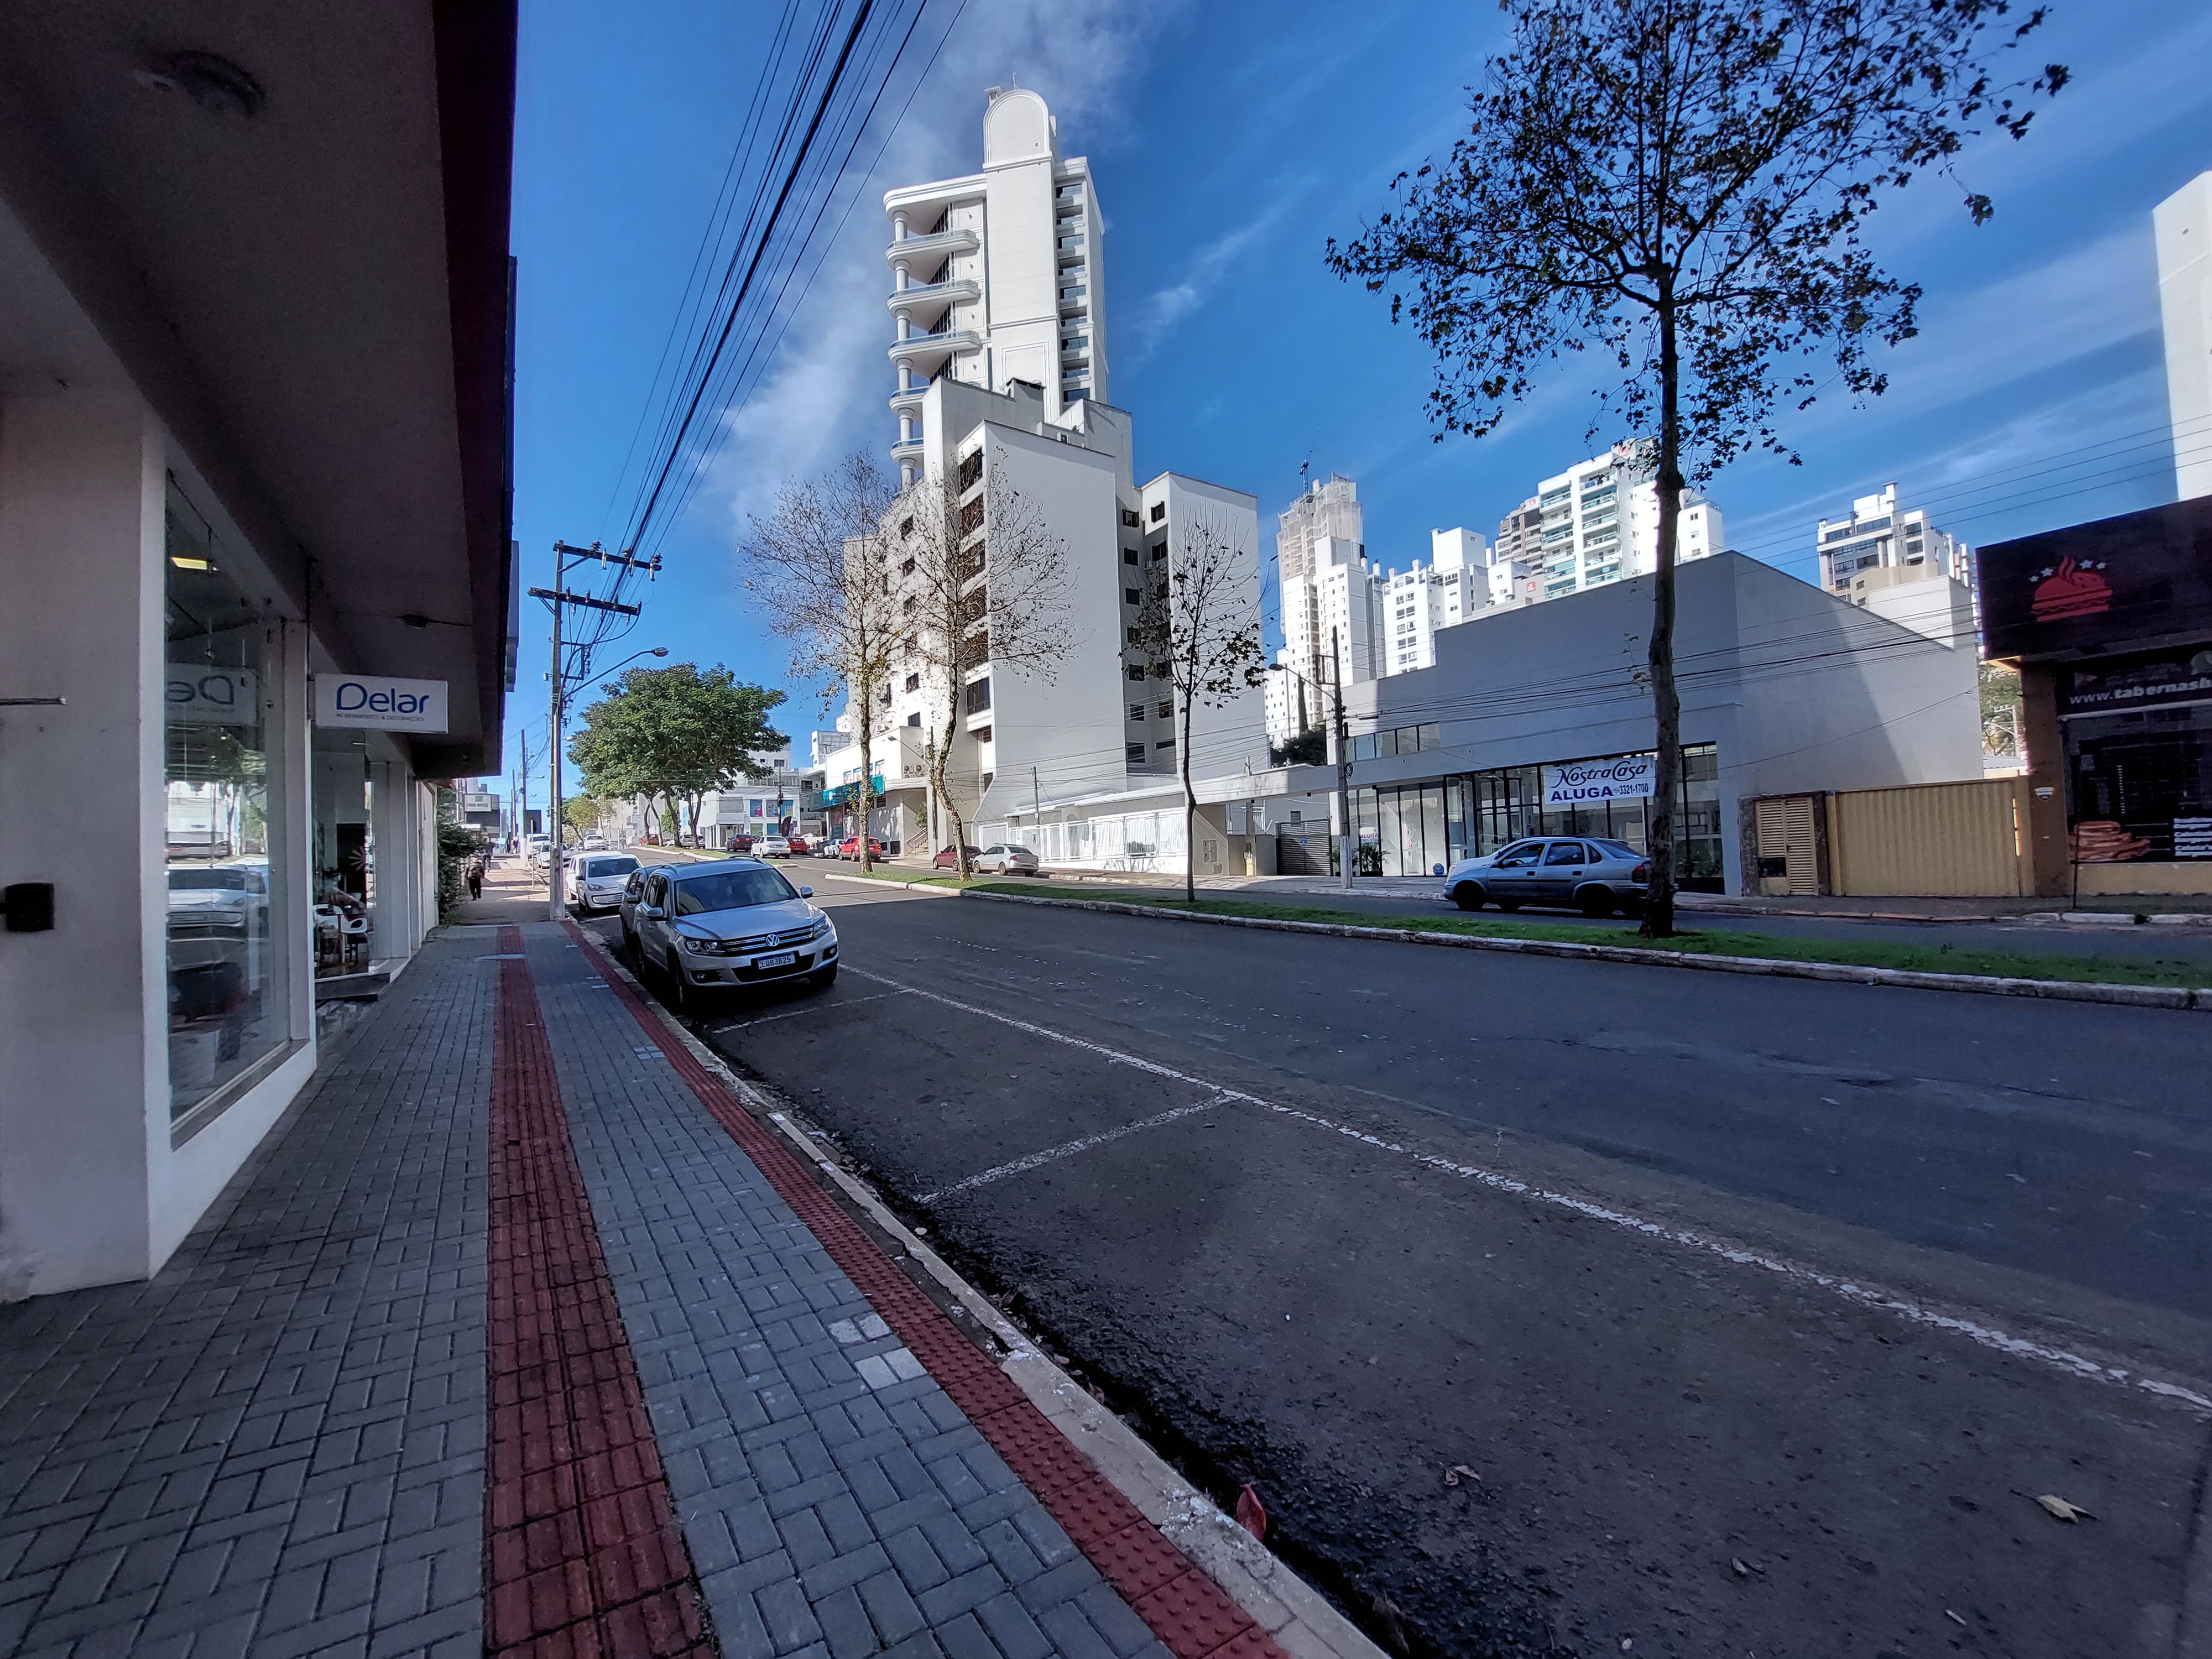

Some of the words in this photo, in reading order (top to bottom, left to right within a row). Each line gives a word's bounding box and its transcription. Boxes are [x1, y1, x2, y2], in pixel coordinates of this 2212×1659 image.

[336, 682, 430, 713] Delar
[1551, 786, 1614, 801] ALUGA
[1619, 782, 1648, 795] 3321-1700
